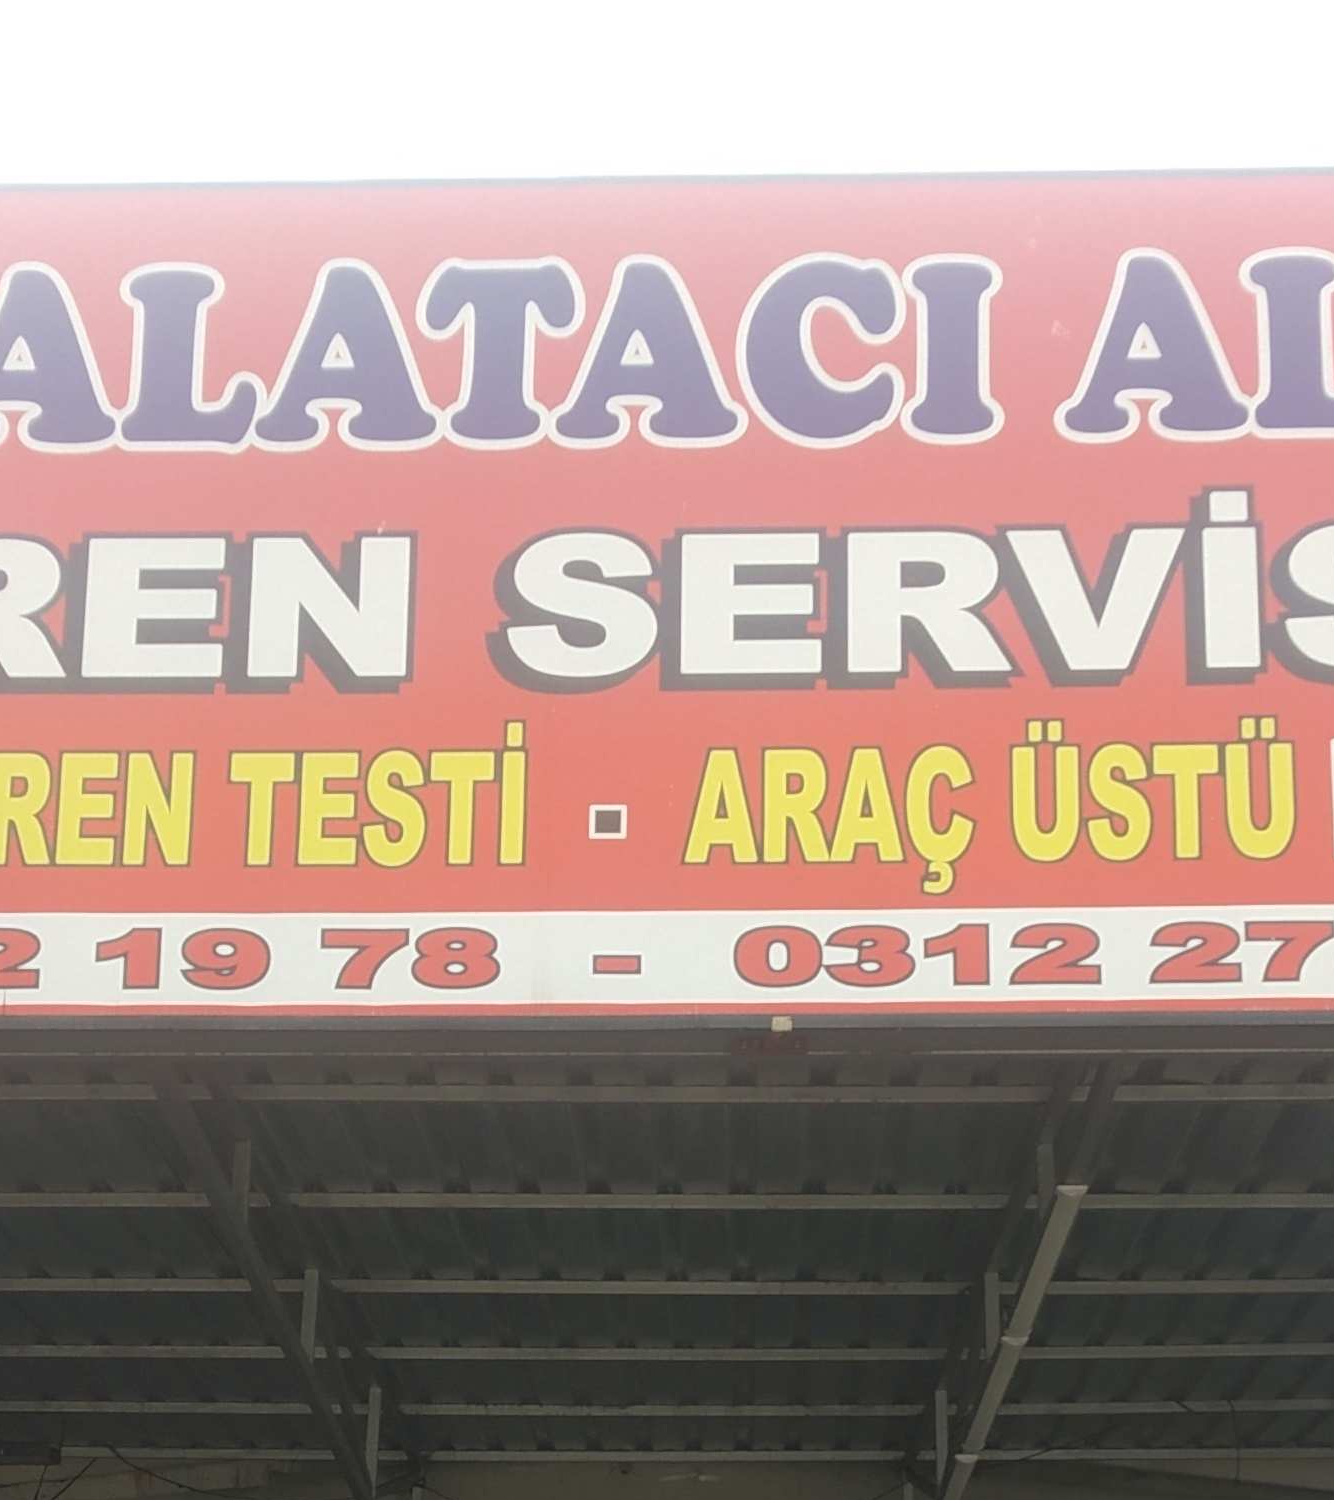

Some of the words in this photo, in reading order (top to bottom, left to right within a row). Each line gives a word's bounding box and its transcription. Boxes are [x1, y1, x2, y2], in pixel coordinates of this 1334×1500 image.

[228, 719, 528, 868] TESTİ
[681, 746, 977, 895] ARAÇ
[1009, 715, 1296, 862] ÜSTÜ
[94, 926, 273, 990] 19
[319, 927, 502, 990] 78
[732, 922, 1103, 988] 0312
